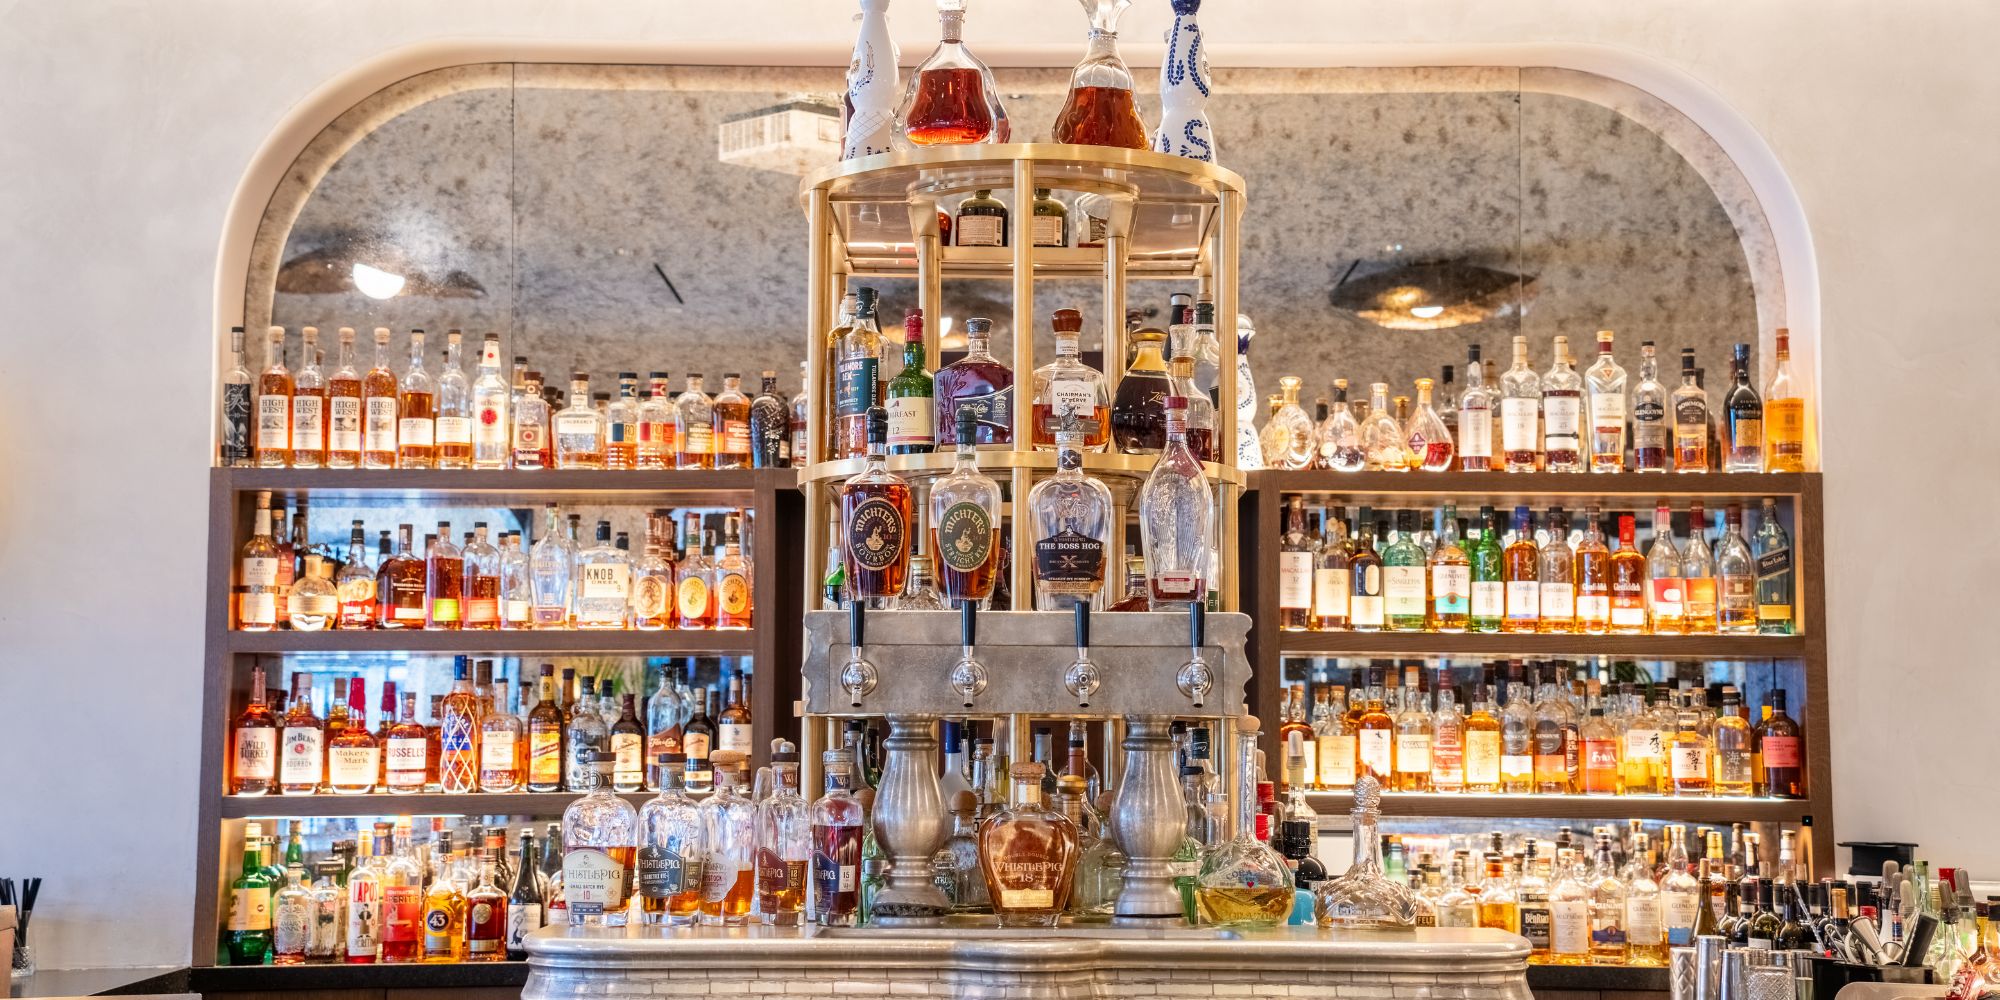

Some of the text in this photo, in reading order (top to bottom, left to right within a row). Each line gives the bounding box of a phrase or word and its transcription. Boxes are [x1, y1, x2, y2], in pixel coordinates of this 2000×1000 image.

[335, 401, 357, 409] HIGH
[371, 401, 393, 409] HIGH
[1678, 402, 1706, 412] BOWMORE
[335, 408, 357, 416] WEST
[1634, 408, 1664, 416] GLENGOYNE
[856, 507, 897, 534] MICHTER'S
[945, 509, 986, 536] MICHTER'S
[1040, 543, 1100, 551] THE BOSS HOG
[856, 542, 896, 564] BOURBON
[586, 569, 613, 580] KNOB
[286, 732, 316, 746] JIM BEAM
[246, 741, 266, 751] WILD
[240, 749, 268, 759] TURKEY
[336, 750, 371, 758] Maker's
[389, 747, 425, 757] RUSSELL'S
[345, 757, 369, 765] Mark
[994, 861, 1063, 872] WHISTLEPIG
[568, 869, 621, 881] HISTLEPIG
[1019, 874, 1034, 883] 18
[583, 890, 591, 901] 10
[429, 914, 446, 927] 43
